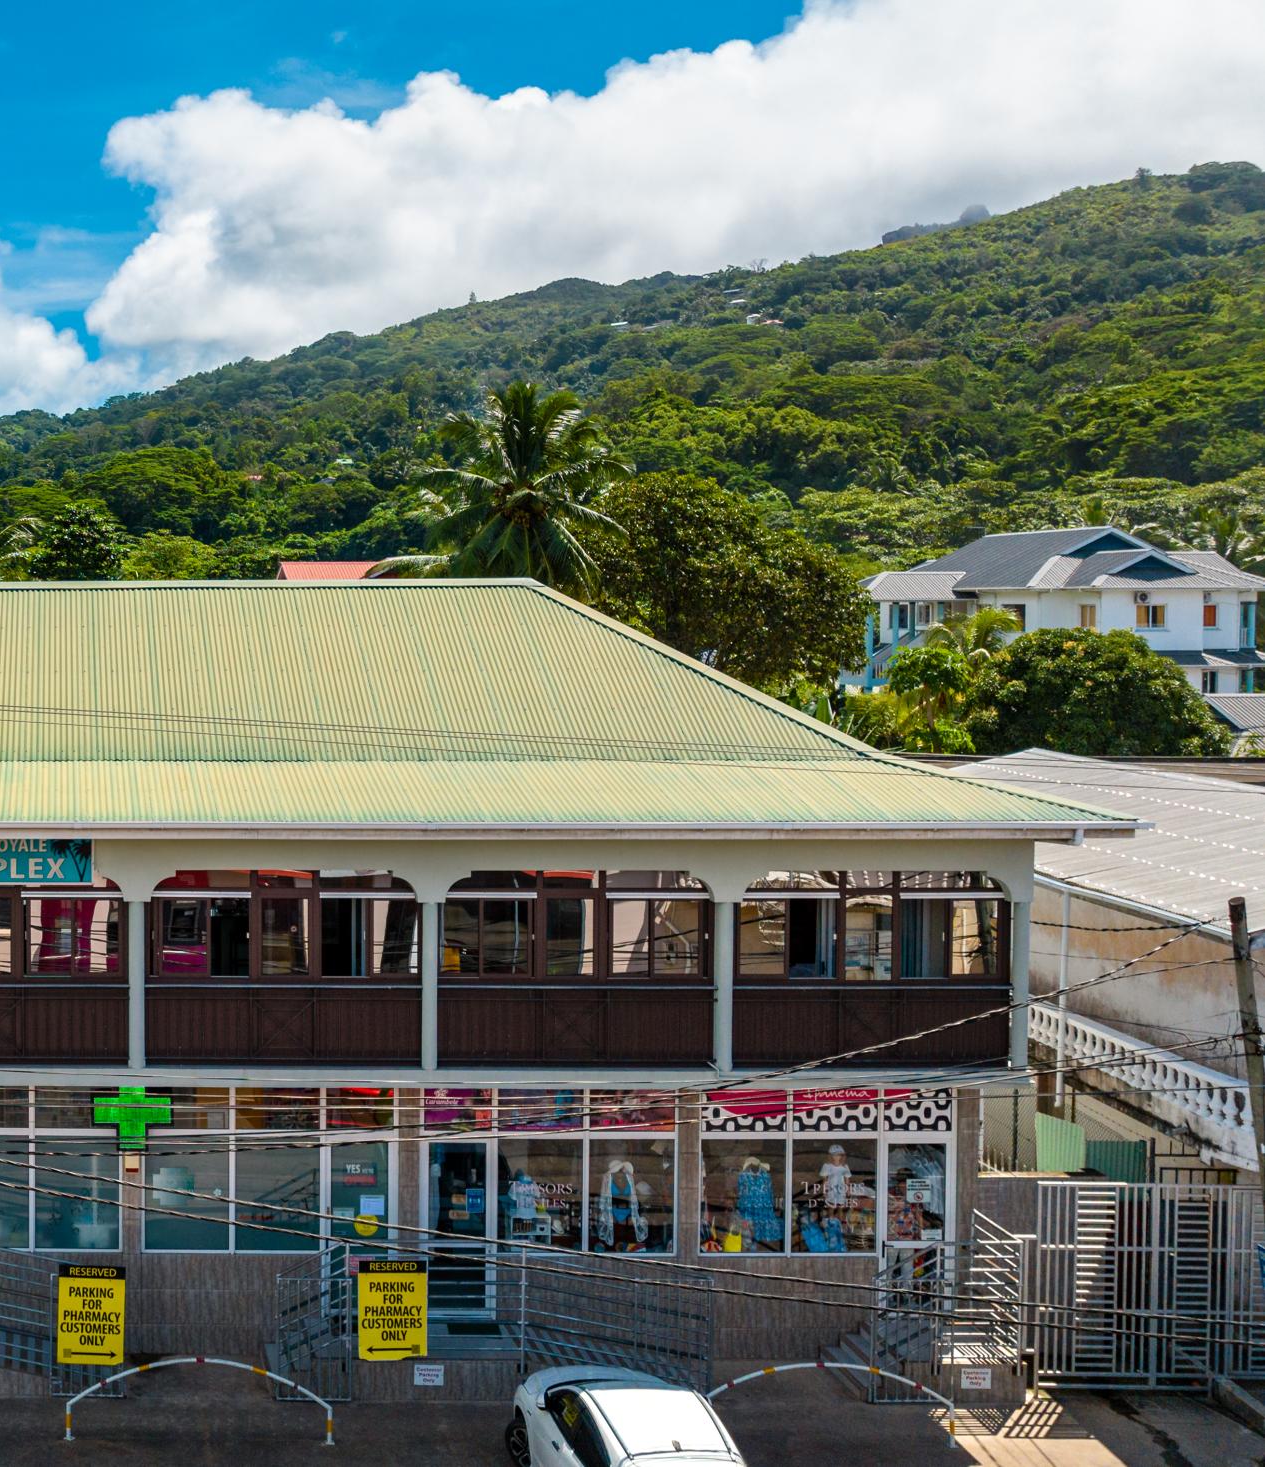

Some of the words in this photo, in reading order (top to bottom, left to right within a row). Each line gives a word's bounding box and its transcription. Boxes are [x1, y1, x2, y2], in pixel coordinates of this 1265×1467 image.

[346, 1164, 361, 1174] YES
[69, 1267, 117, 1277] RESERVED
[369, 1263, 418, 1271] RESERVED
[68, 1286, 114, 1299] PARKING
[369, 1281, 415, 1293] PARKING
[82, 1298, 102, 1310] FOR
[383, 1293, 403, 1304] FOR
[63, 1310, 121, 1323] PHARMACY
[364, 1305, 423, 1317] PHARMACY
[60, 1322, 121, 1335] CUSTOMERS
[361, 1318, 423, 1329] CUSTOMERS
[79, 1334, 106, 1347] ONLY
[381, 1330, 408, 1341] ONLY
